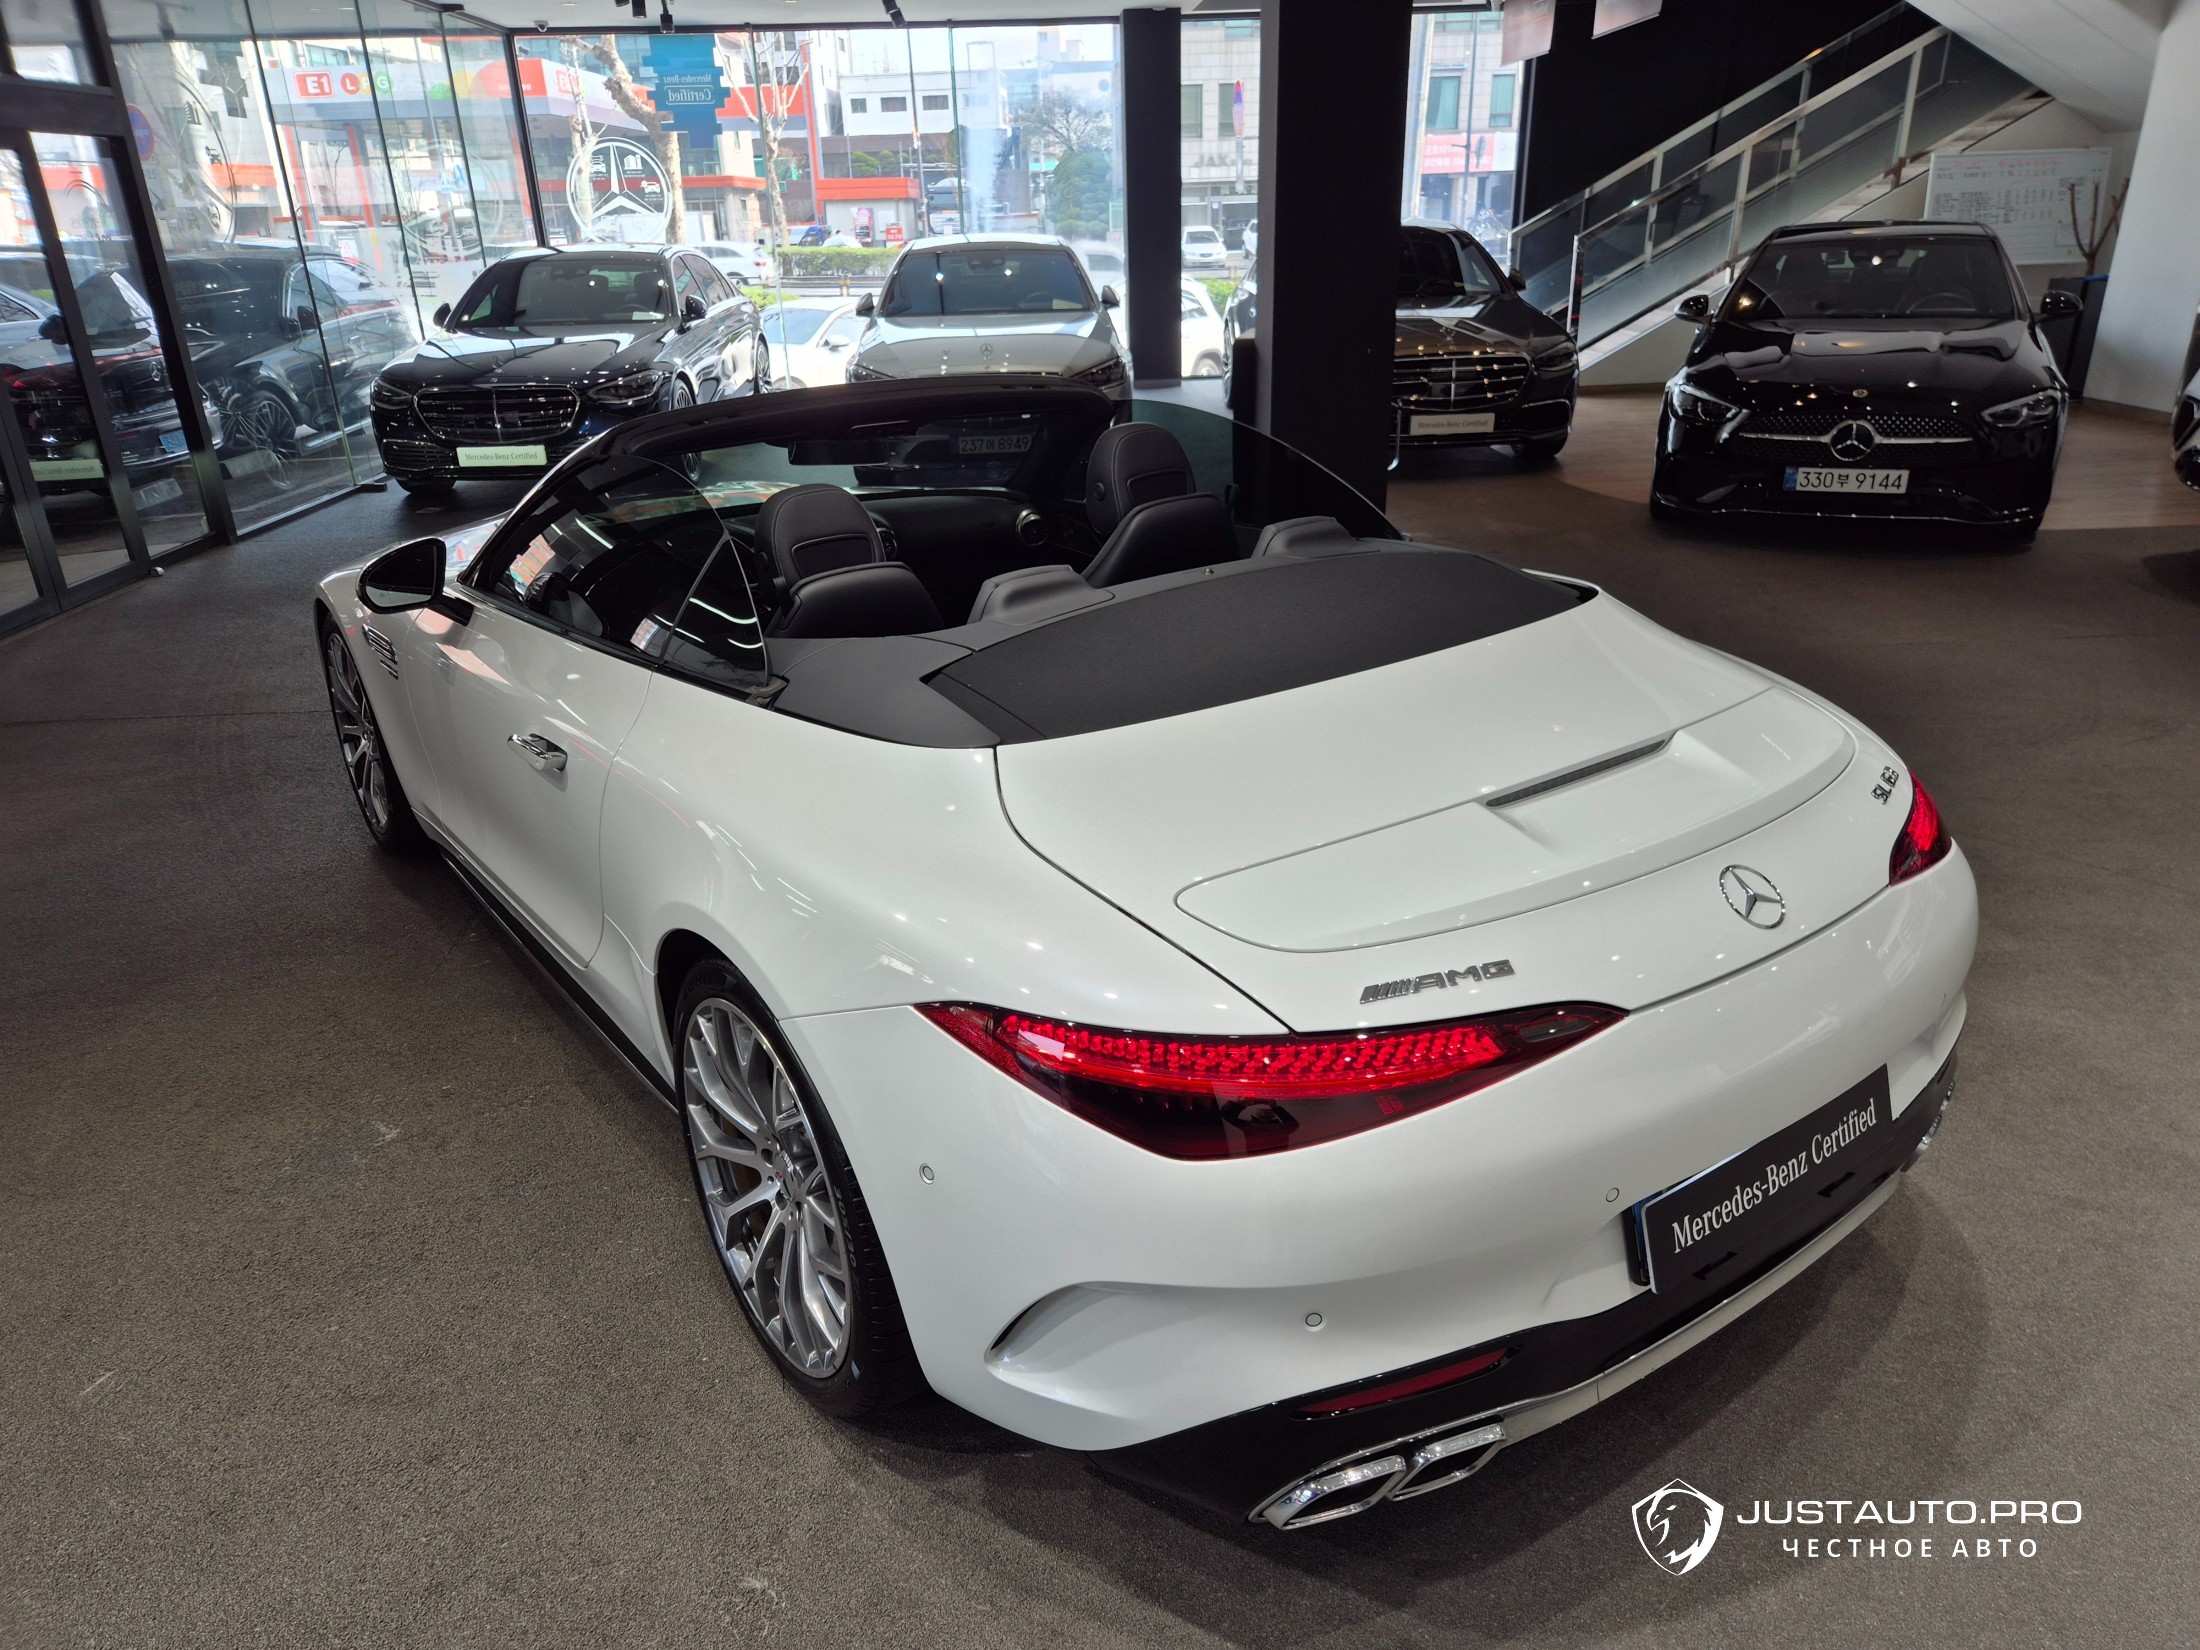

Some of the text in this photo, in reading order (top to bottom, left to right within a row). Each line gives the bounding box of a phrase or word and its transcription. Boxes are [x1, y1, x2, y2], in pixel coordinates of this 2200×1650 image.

[304, 74, 391, 95] E1 LPG
[1418, 420, 1488, 429] Mercedes-Benz Certified
[998, 436, 1030, 451] 8949
[465, 451, 538, 460] Mercedes-Benz Certified
[1800, 471, 1903, 490] 330부 9144
[1409, 959, 1516, 994] AMG
[1671, 1097, 1877, 1254] Mercedes-Benz Certified
